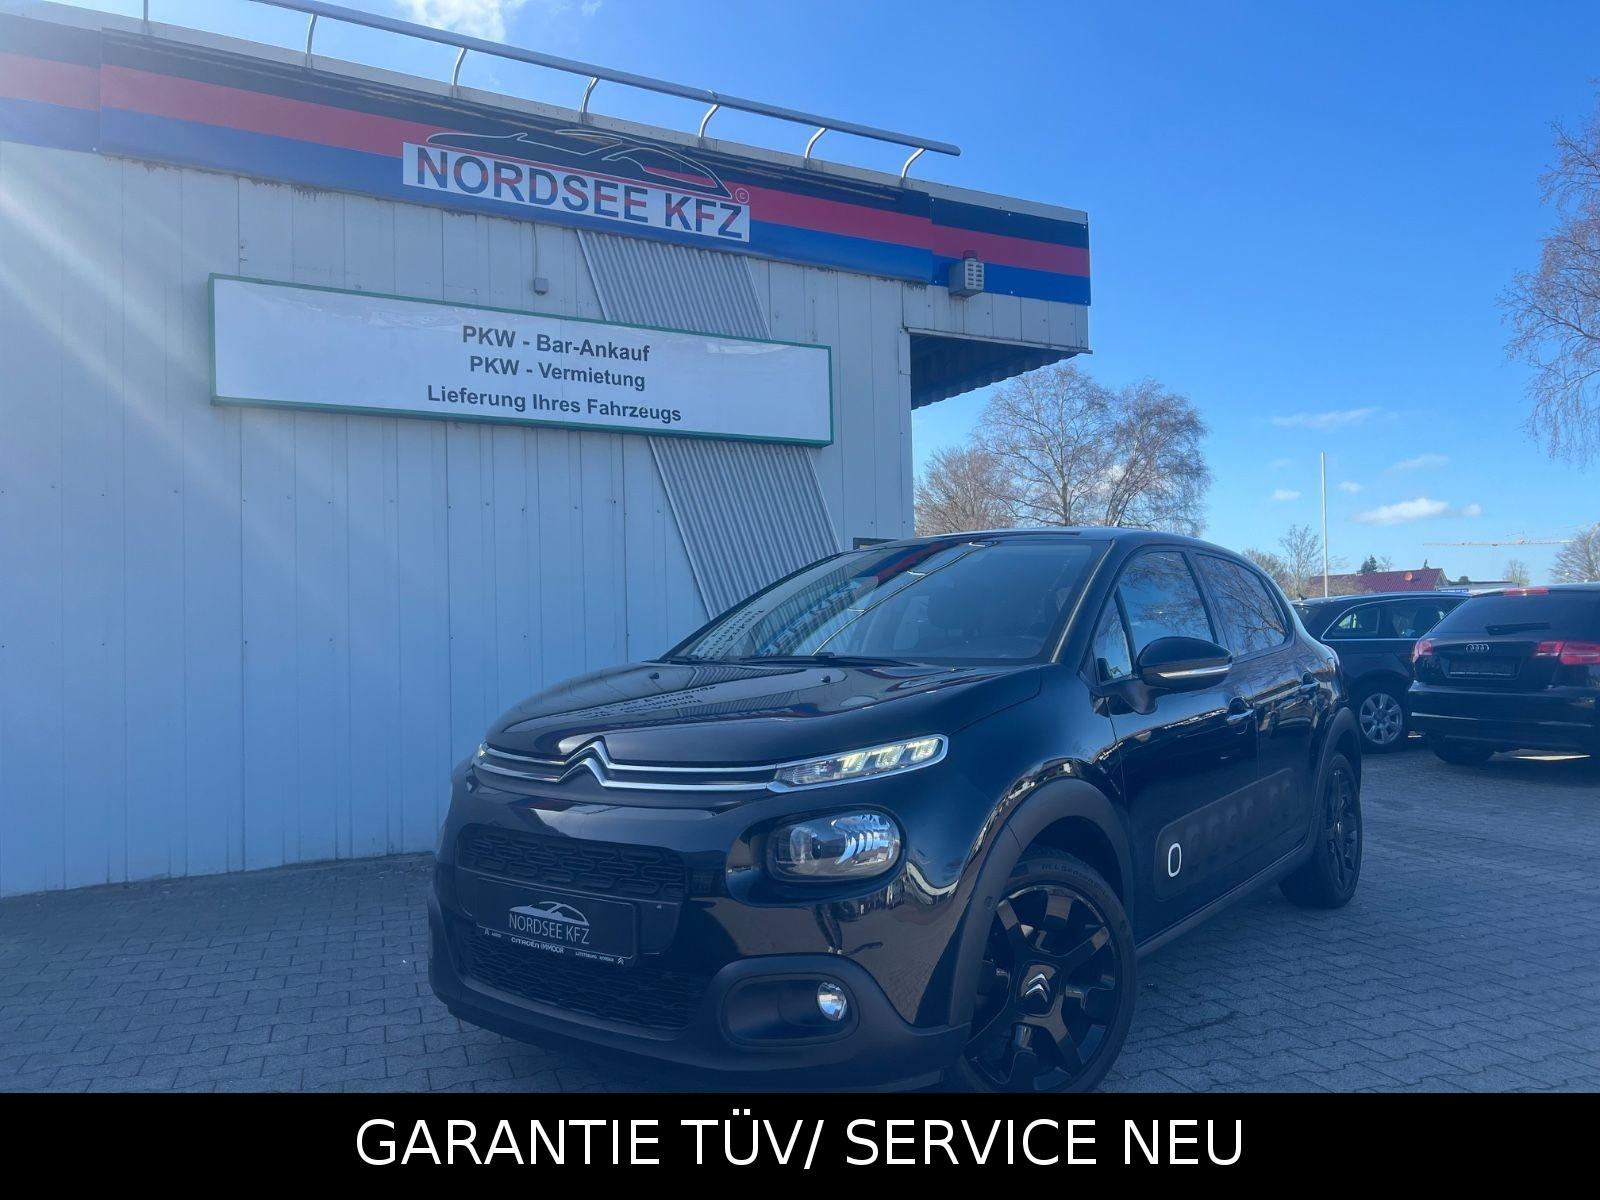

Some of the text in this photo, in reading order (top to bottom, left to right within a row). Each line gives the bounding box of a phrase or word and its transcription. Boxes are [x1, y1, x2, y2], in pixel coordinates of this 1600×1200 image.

[417, 147, 743, 239] NORDSEE KFZ
[463, 325, 516, 348] PKW
[536, 333, 651, 362] Bar-Ankauf
[470, 355, 520, 376] PKW
[538, 361, 646, 392] Vermietung
[427, 384, 682, 425] Lieferung Ihres Fahrzeugs
[509, 914, 590, 945] NORDSEE KFZ
